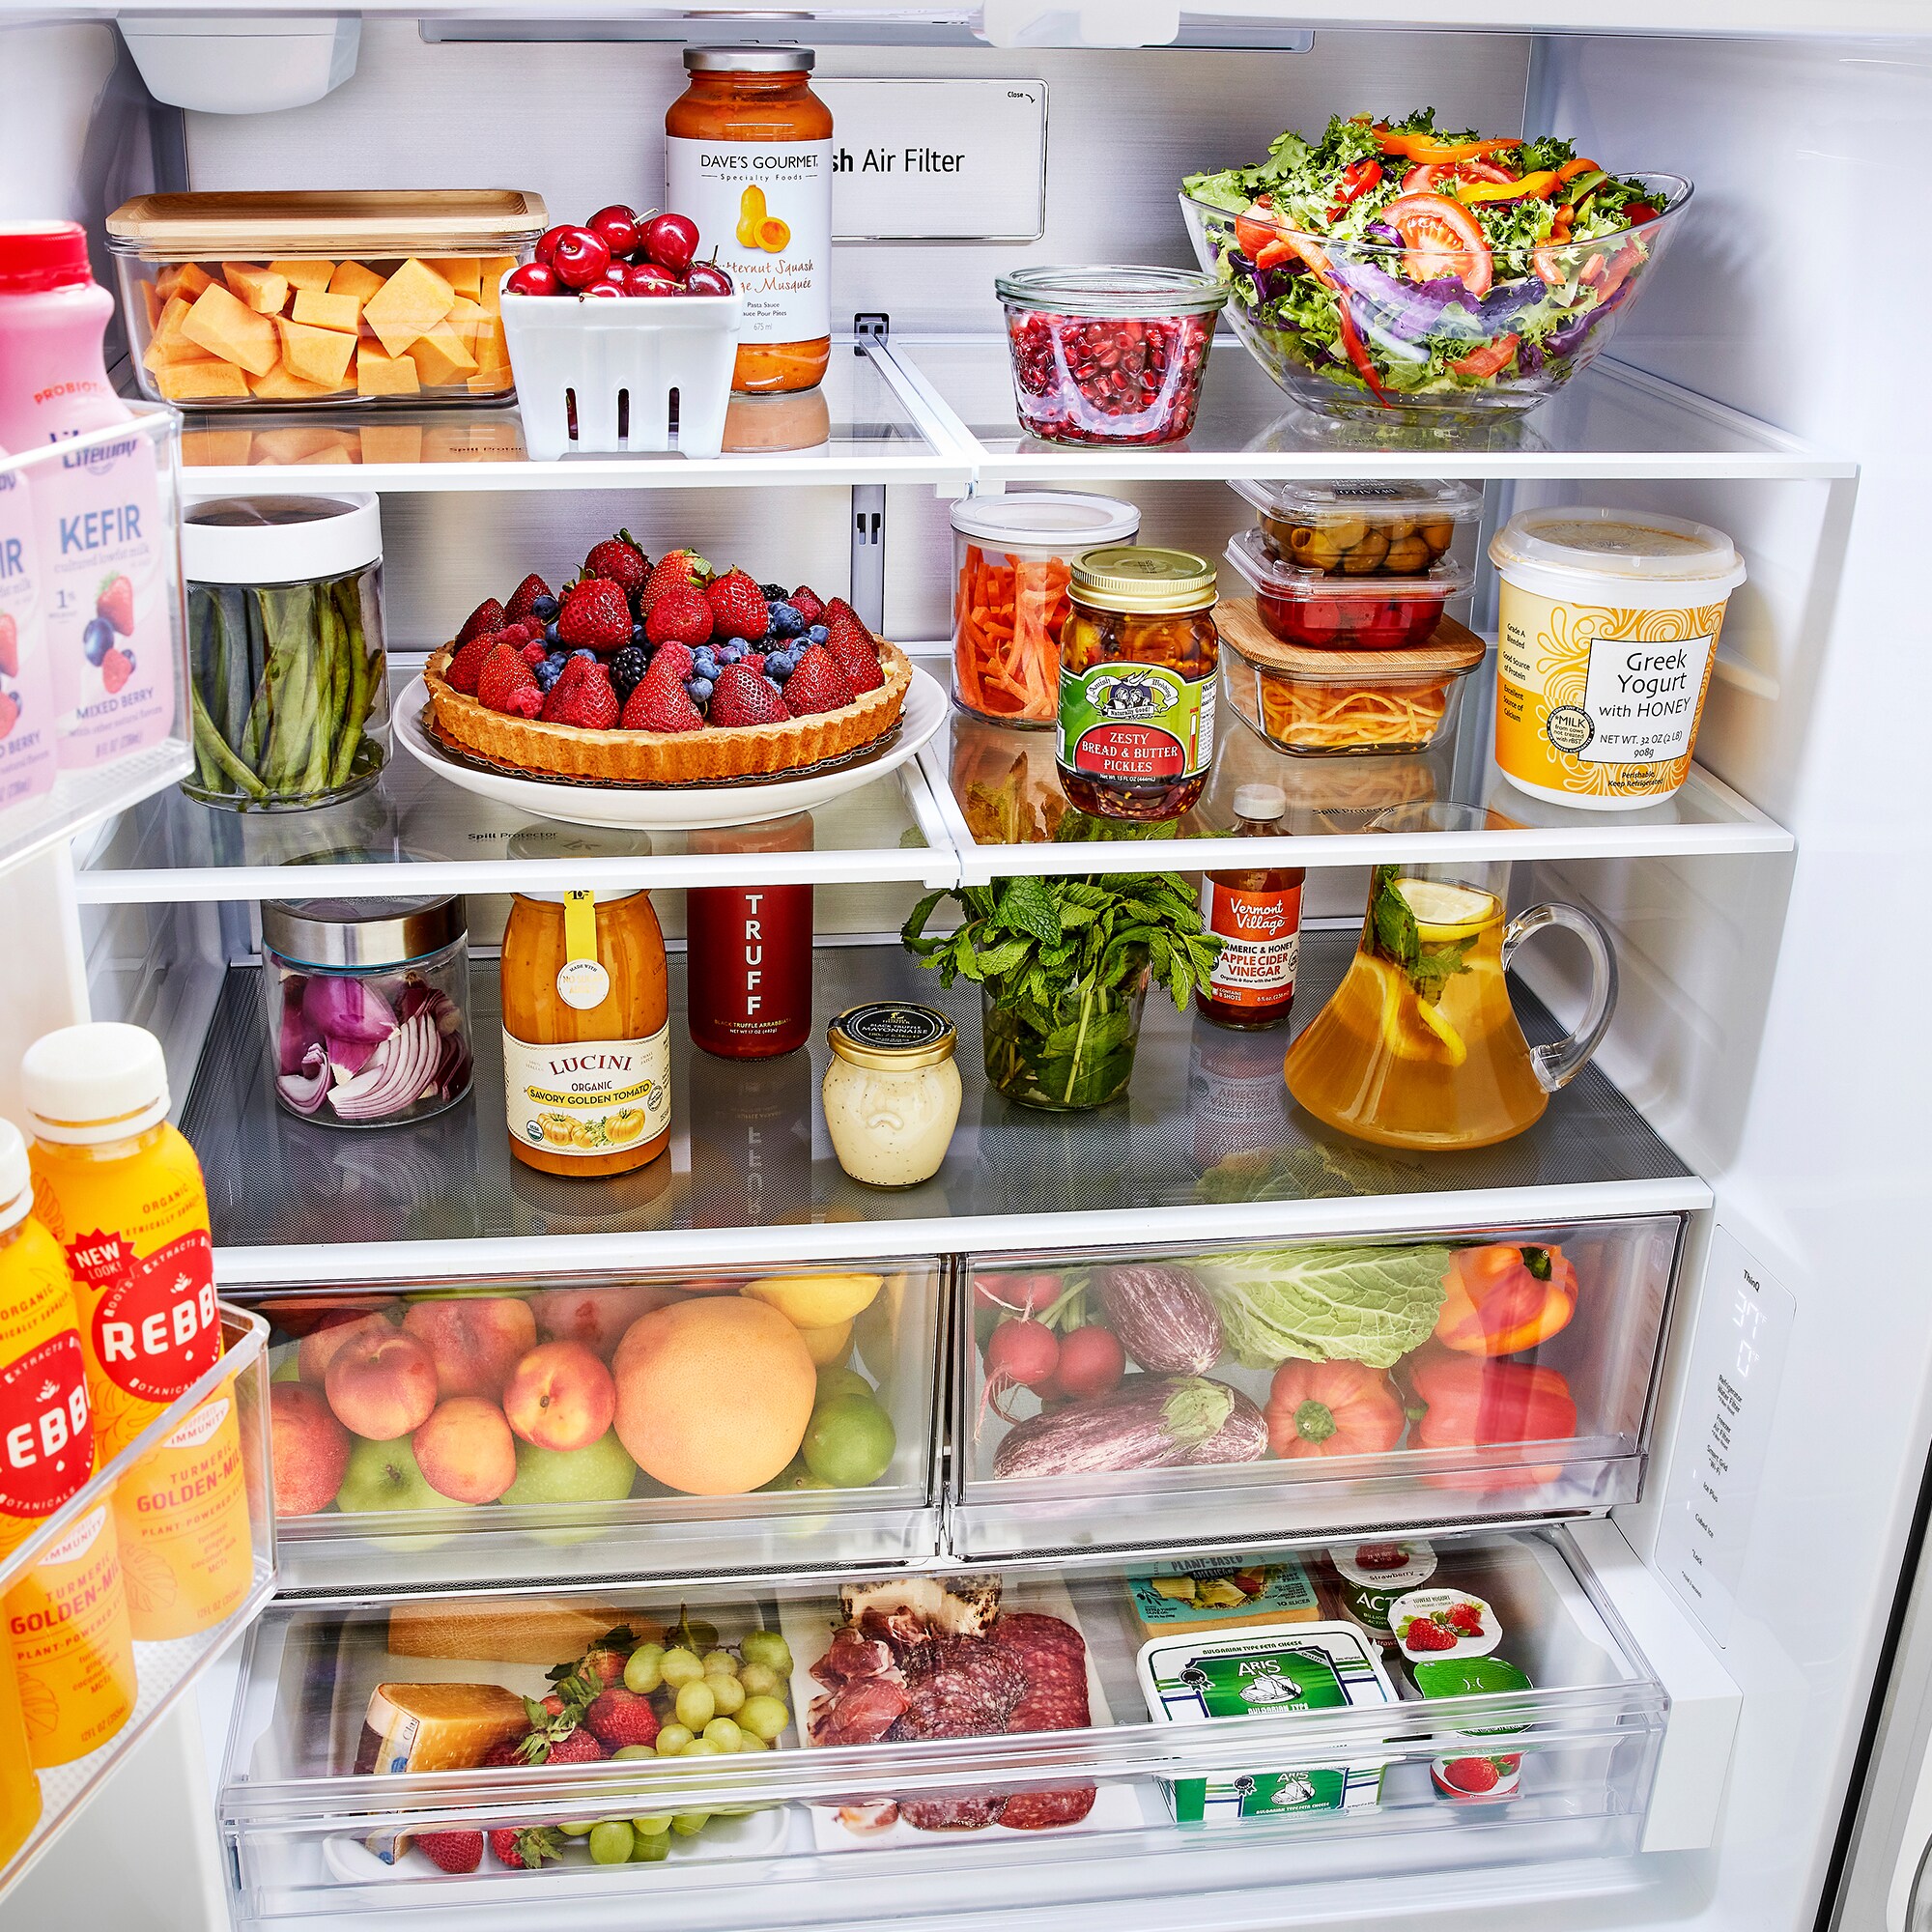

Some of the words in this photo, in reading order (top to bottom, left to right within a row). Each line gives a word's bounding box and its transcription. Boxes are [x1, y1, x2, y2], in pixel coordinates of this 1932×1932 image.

[700, 155, 748, 169] DAVE'S
[862, 148, 896, 172] Air
[904, 148, 966, 172] Filter
[720, 173, 770, 182] Specialty
[776, 259, 814, 276] Squash
[754, 277, 811, 294] Musquée
[753, 323, 764, 331] 675
[59, 503, 142, 555] KEFIR
[1507, 623, 1521, 637] Grade
[1507, 635, 1525, 650] Blended
[1513, 657, 1531, 671] Source
[1627, 649, 1688, 671] Greek
[1618, 672, 1688, 698] Yogurt
[75, 697, 118, 721] MIXED
[121, 687, 155, 708] BERRY
[1599, 704, 1632, 718] with
[1637, 696, 1691, 718] HONEY
[1110, 732, 1151, 745] ZESTY
[1600, 734, 1619, 744] NET
[1640, 736, 1650, 747] 32
[1652, 734, 1664, 744] OZ
[1081, 741, 1118, 757] BREAD
[1121, 748, 1129, 758] &
[1133, 746, 1179, 759] BUTTER
[1634, 748, 1655, 758] 908g
[1103, 759, 1152, 773] PICKLES
[1607, 780, 1626, 788] Keep
[468, 832, 497, 840] Spill
[1230, 897, 1284, 915] Vermont
[1236, 914, 1286, 936] Village
[745, 894, 763, 1015] TRUFF
[1224, 943, 1258, 954] RMERIC
[1268, 941, 1293, 953] HONEY
[569, 963, 583, 973] MADE
[584, 963, 598, 973] WITH
[1221, 952, 1257, 966] APPLE
[1258, 952, 1289, 966] CIDER
[1228, 964, 1281, 978] VINEGAR
[862, 1026, 928, 1035] MAYONNAISE
[548, 1054, 632, 1076] LUCINI
[529, 1089, 565, 1104] SAVORY
[567, 1094, 611, 1105] GOLDEN
[614, 1082, 650, 1100] TOMATO
[571, 1080, 612, 1092] ORGANIC
[142, 1182, 190, 1214] ORGANIC
[74, 1240, 121, 1268] NEW
[142, 1236, 196, 1275] EXTRACTS
[88, 1261, 124, 1280] LOOK!
[1744, 1268, 1760, 1293] ThinQ
[0, 1283, 54, 1321] ORGANIC
[103, 1281, 134, 1318] ROOTS
[4, 1341, 63, 1384] EXTRACTS
[1719, 1374, 1743, 1403] Refrigerator
[1718, 1383, 1729, 1402] Water
[1728, 1397, 1741, 1413] Filter
[0, 1383, 89, 1470] EBB
[171, 1407, 226, 1445] IMMUNITY
[1716, 1413, 1731, 1434] Freezer
[170, 1440, 232, 1484] TURMERIC
[136, 1447, 242, 1513] GOLDEN-MIL
[1709, 1488, 1719, 1503] Plus
[1694, 1513, 1708, 1531] Cubed
[1171, 1555, 1243, 1572] PLANT-BASED
[1193, 1567, 1235, 1579] AMERICAN
[1369, 1571, 1414, 1581] Strawberry
[10, 1555, 119, 1634] GOLDEN-MIL
[1202, 1645, 1242, 1656] BULGARIAN
[1260, 1642, 1277, 1651] FETA
[1277, 1639, 1303, 1650] CHEESE
[1301, 1651, 1325, 1663] QUALITY
[1237, 1659, 1283, 1677] ARIS
[1247, 1704, 1290, 1716] BULGARIAN
[1291, 1702, 1310, 1712] TYPE
